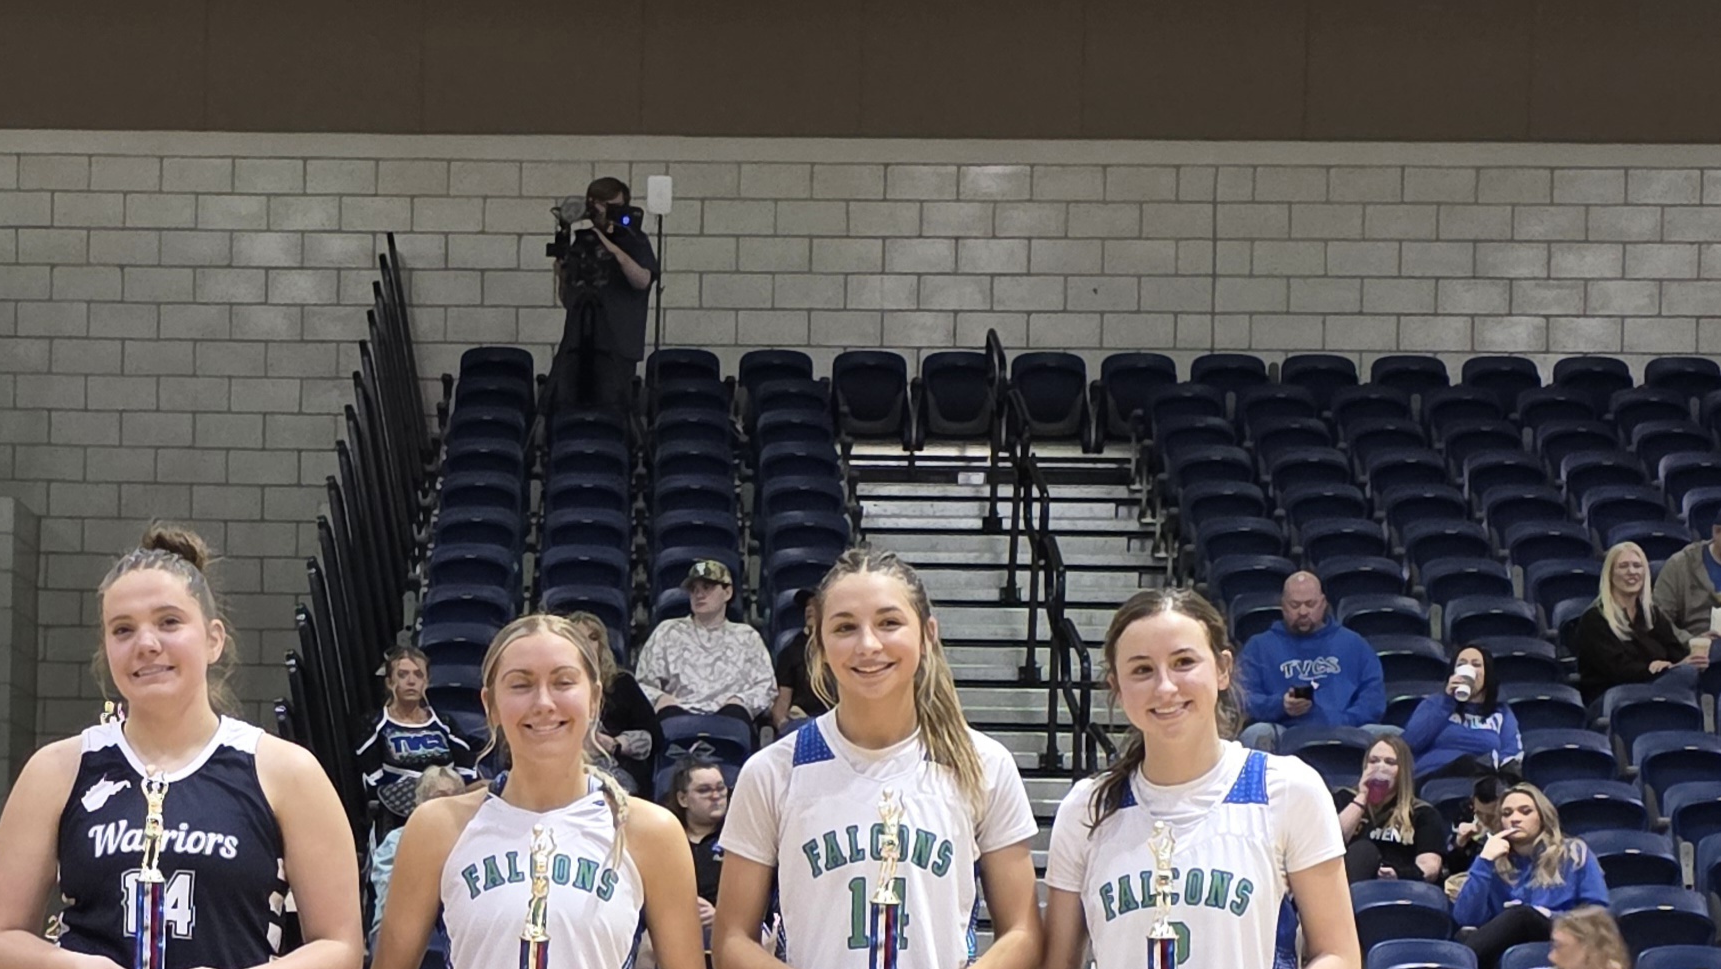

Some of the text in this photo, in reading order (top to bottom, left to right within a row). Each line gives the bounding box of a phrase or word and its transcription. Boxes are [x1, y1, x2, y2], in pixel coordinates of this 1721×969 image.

[87, 818, 240, 860] Wariors
[461, 850, 620, 903] FALONS
[120, 867, 196, 940] 14
